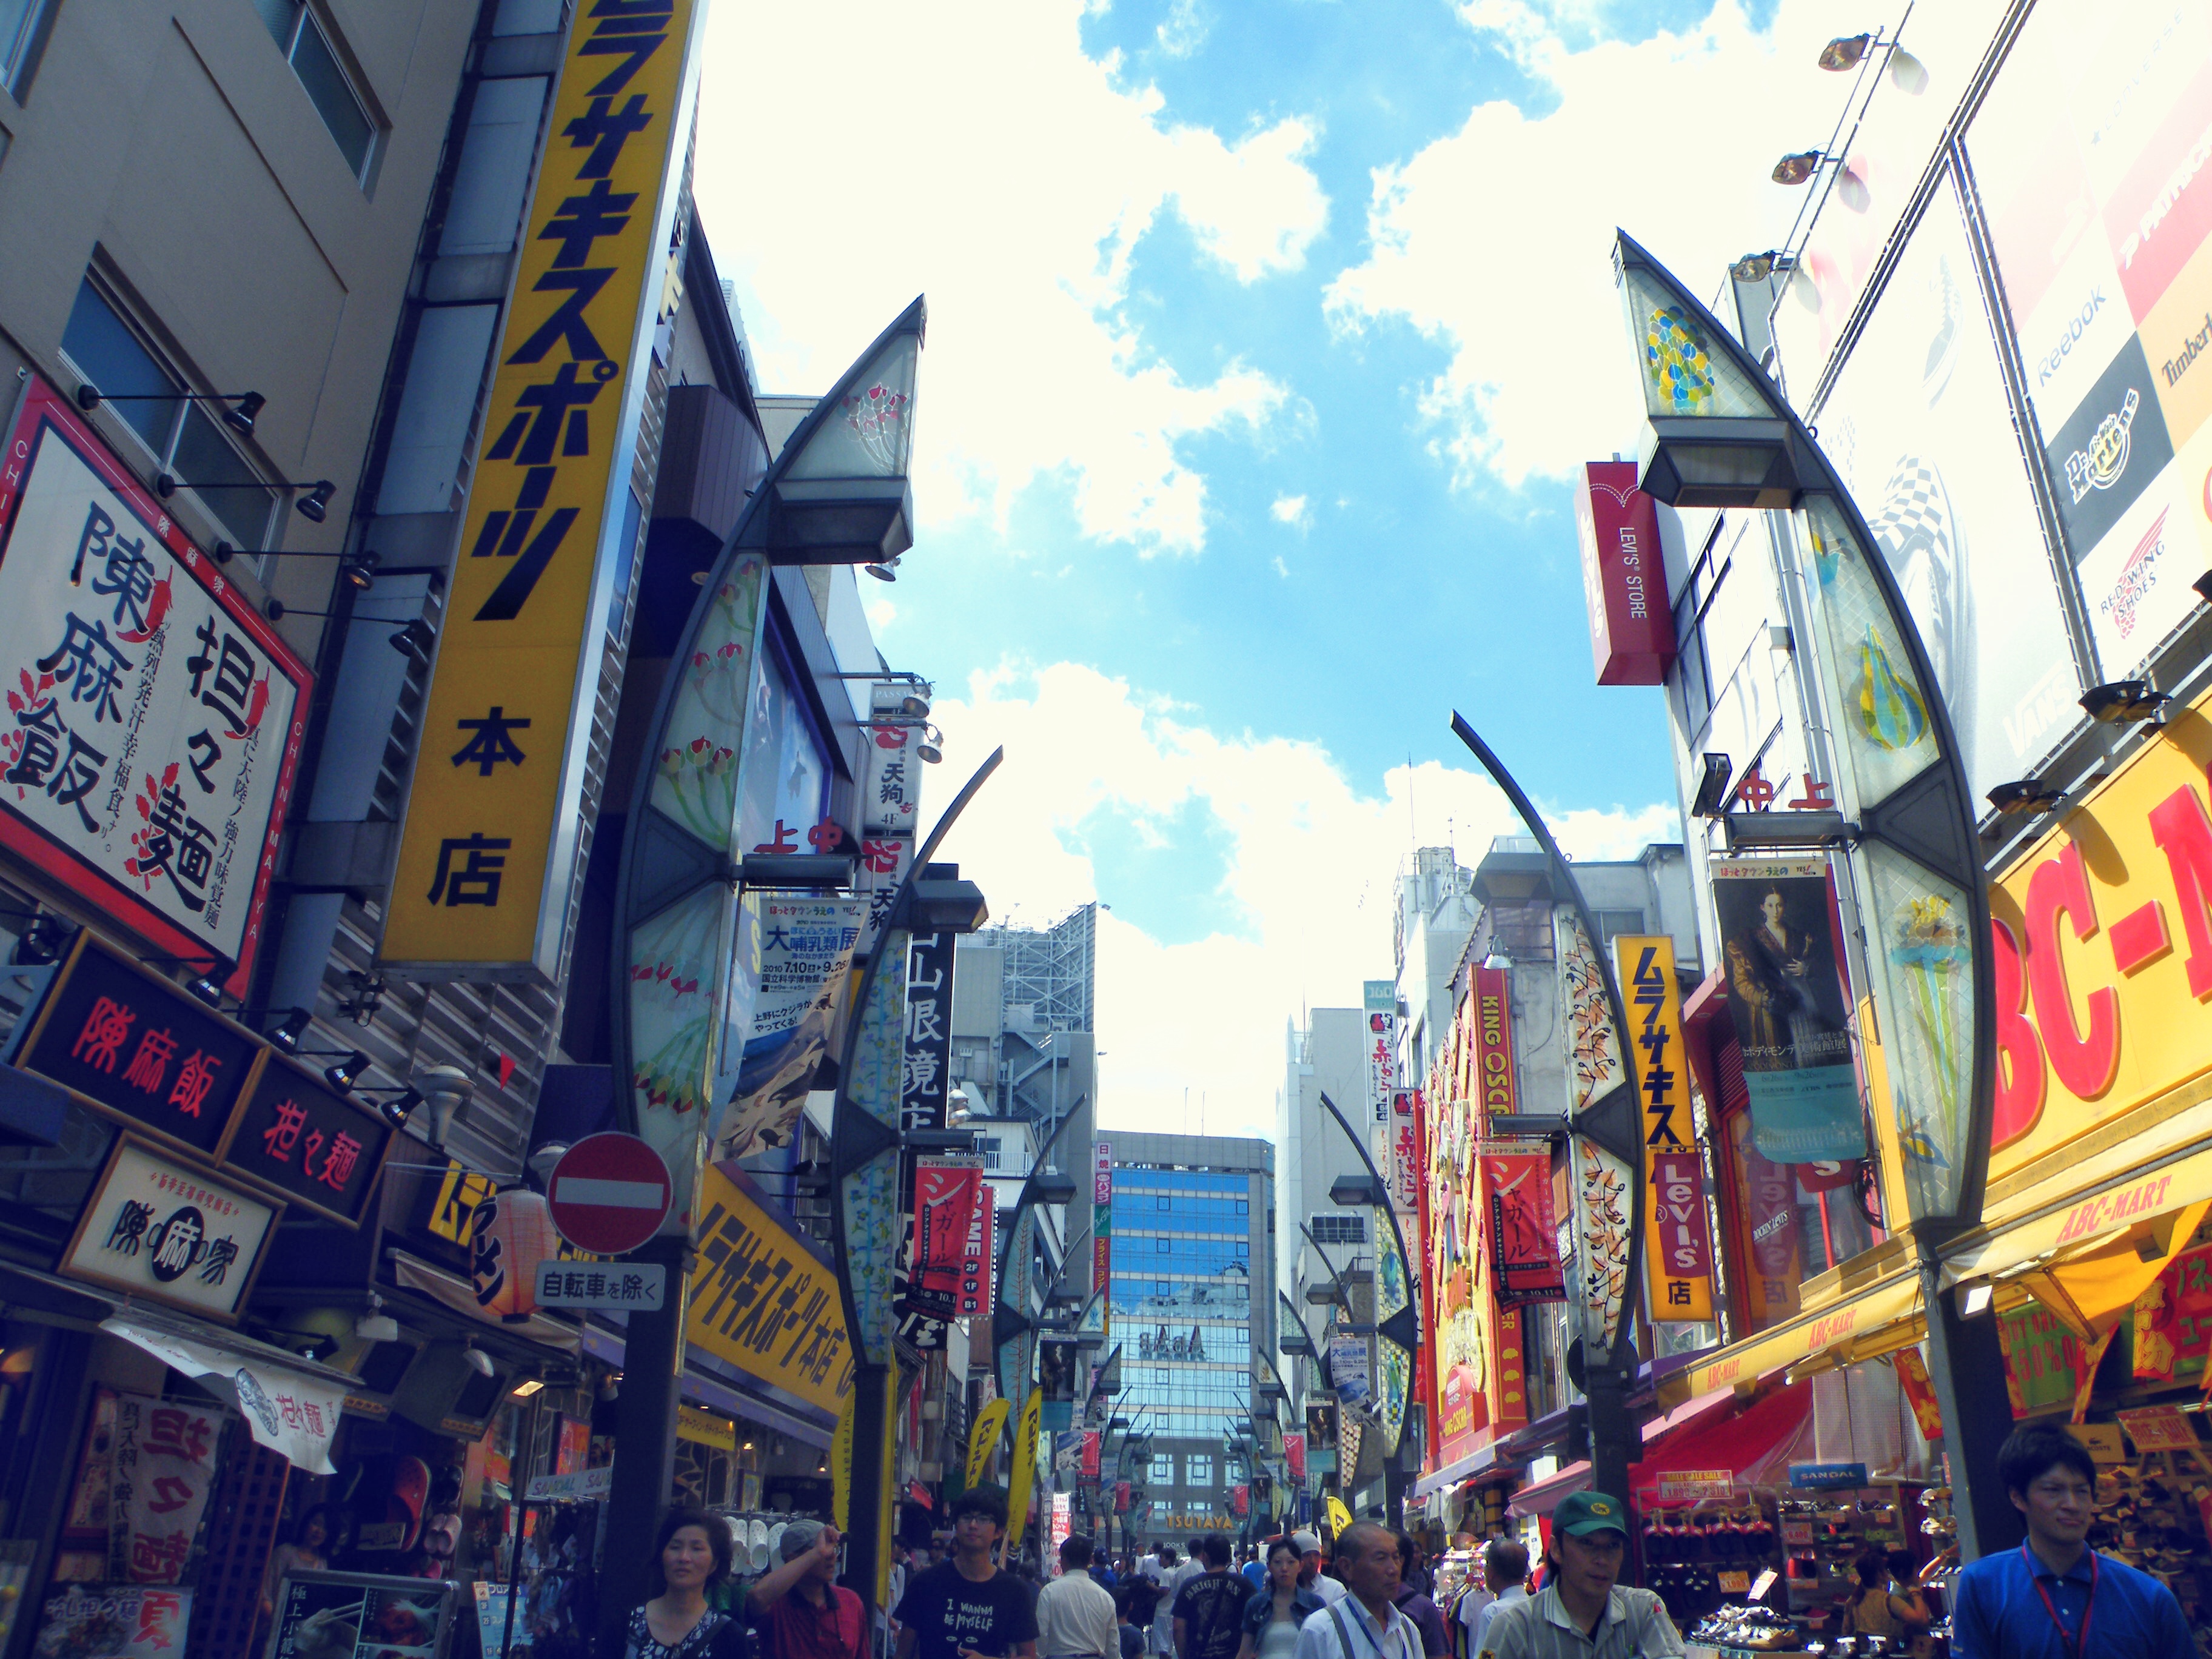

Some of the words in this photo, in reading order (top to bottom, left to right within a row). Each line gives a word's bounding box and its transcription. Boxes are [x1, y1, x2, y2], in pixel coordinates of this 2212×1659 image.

[472, 0, 674, 620] ラサキスポーツ
[2037, 284, 2106, 387] Reebok
[2071, 392, 2137, 501] Martens
[1626, 576, 1647, 618] STORE
[2101, 581, 2123, 615] RED
[2127, 541, 2165, 585] WING
[2118, 575, 2157, 618] SHOES
[5, 501, 155, 833] 陳麻飯
[138, 615, 255, 912] 担々麺
[880, 763, 904, 804] 天狗
[881, 813, 899, 824] 4F
[1721, 867, 1788, 877] ほっとタウンうえの
[769, 906, 834, 916] ほっとタウンうえの
[762, 974, 820, 983] 国立科学博物館
[754, 1000, 812, 1022] 上野にクジラが
[756, 1016, 797, 1032] やってくる!
[1482, 996, 1501, 1045] KING
[72, 996, 223, 1118] 陳麻飯
[1484, 1052, 1511, 1116] OSCA
[264, 1099, 362, 1192] 担々麺
[925, 1173, 966, 1264] シャガール
[1490, 1162, 1532, 1261] シャガール
[2056, 1175, 2171, 1244] ABC-MART
[107, 1199, 239, 1285] 陳麻家
[543, 1272, 656, 1300] 自転車を除く
[689, 1202, 848, 1387] ラサキスポーツ本店
[965, 1282, 977, 1290] 1F
[1809, 1310, 1856, 1349] ABC-MART
[1708, 1359, 1740, 1390] ABC-MART
[1800, 1470, 1856, 1480] SANDAL
[1167, 1516, 1233, 1529] TSUTAYA
[947, 1598, 954, 1610] I
[960, 1601, 993, 1615] WANNA
[956, 1613, 993, 1632] MYSELF
